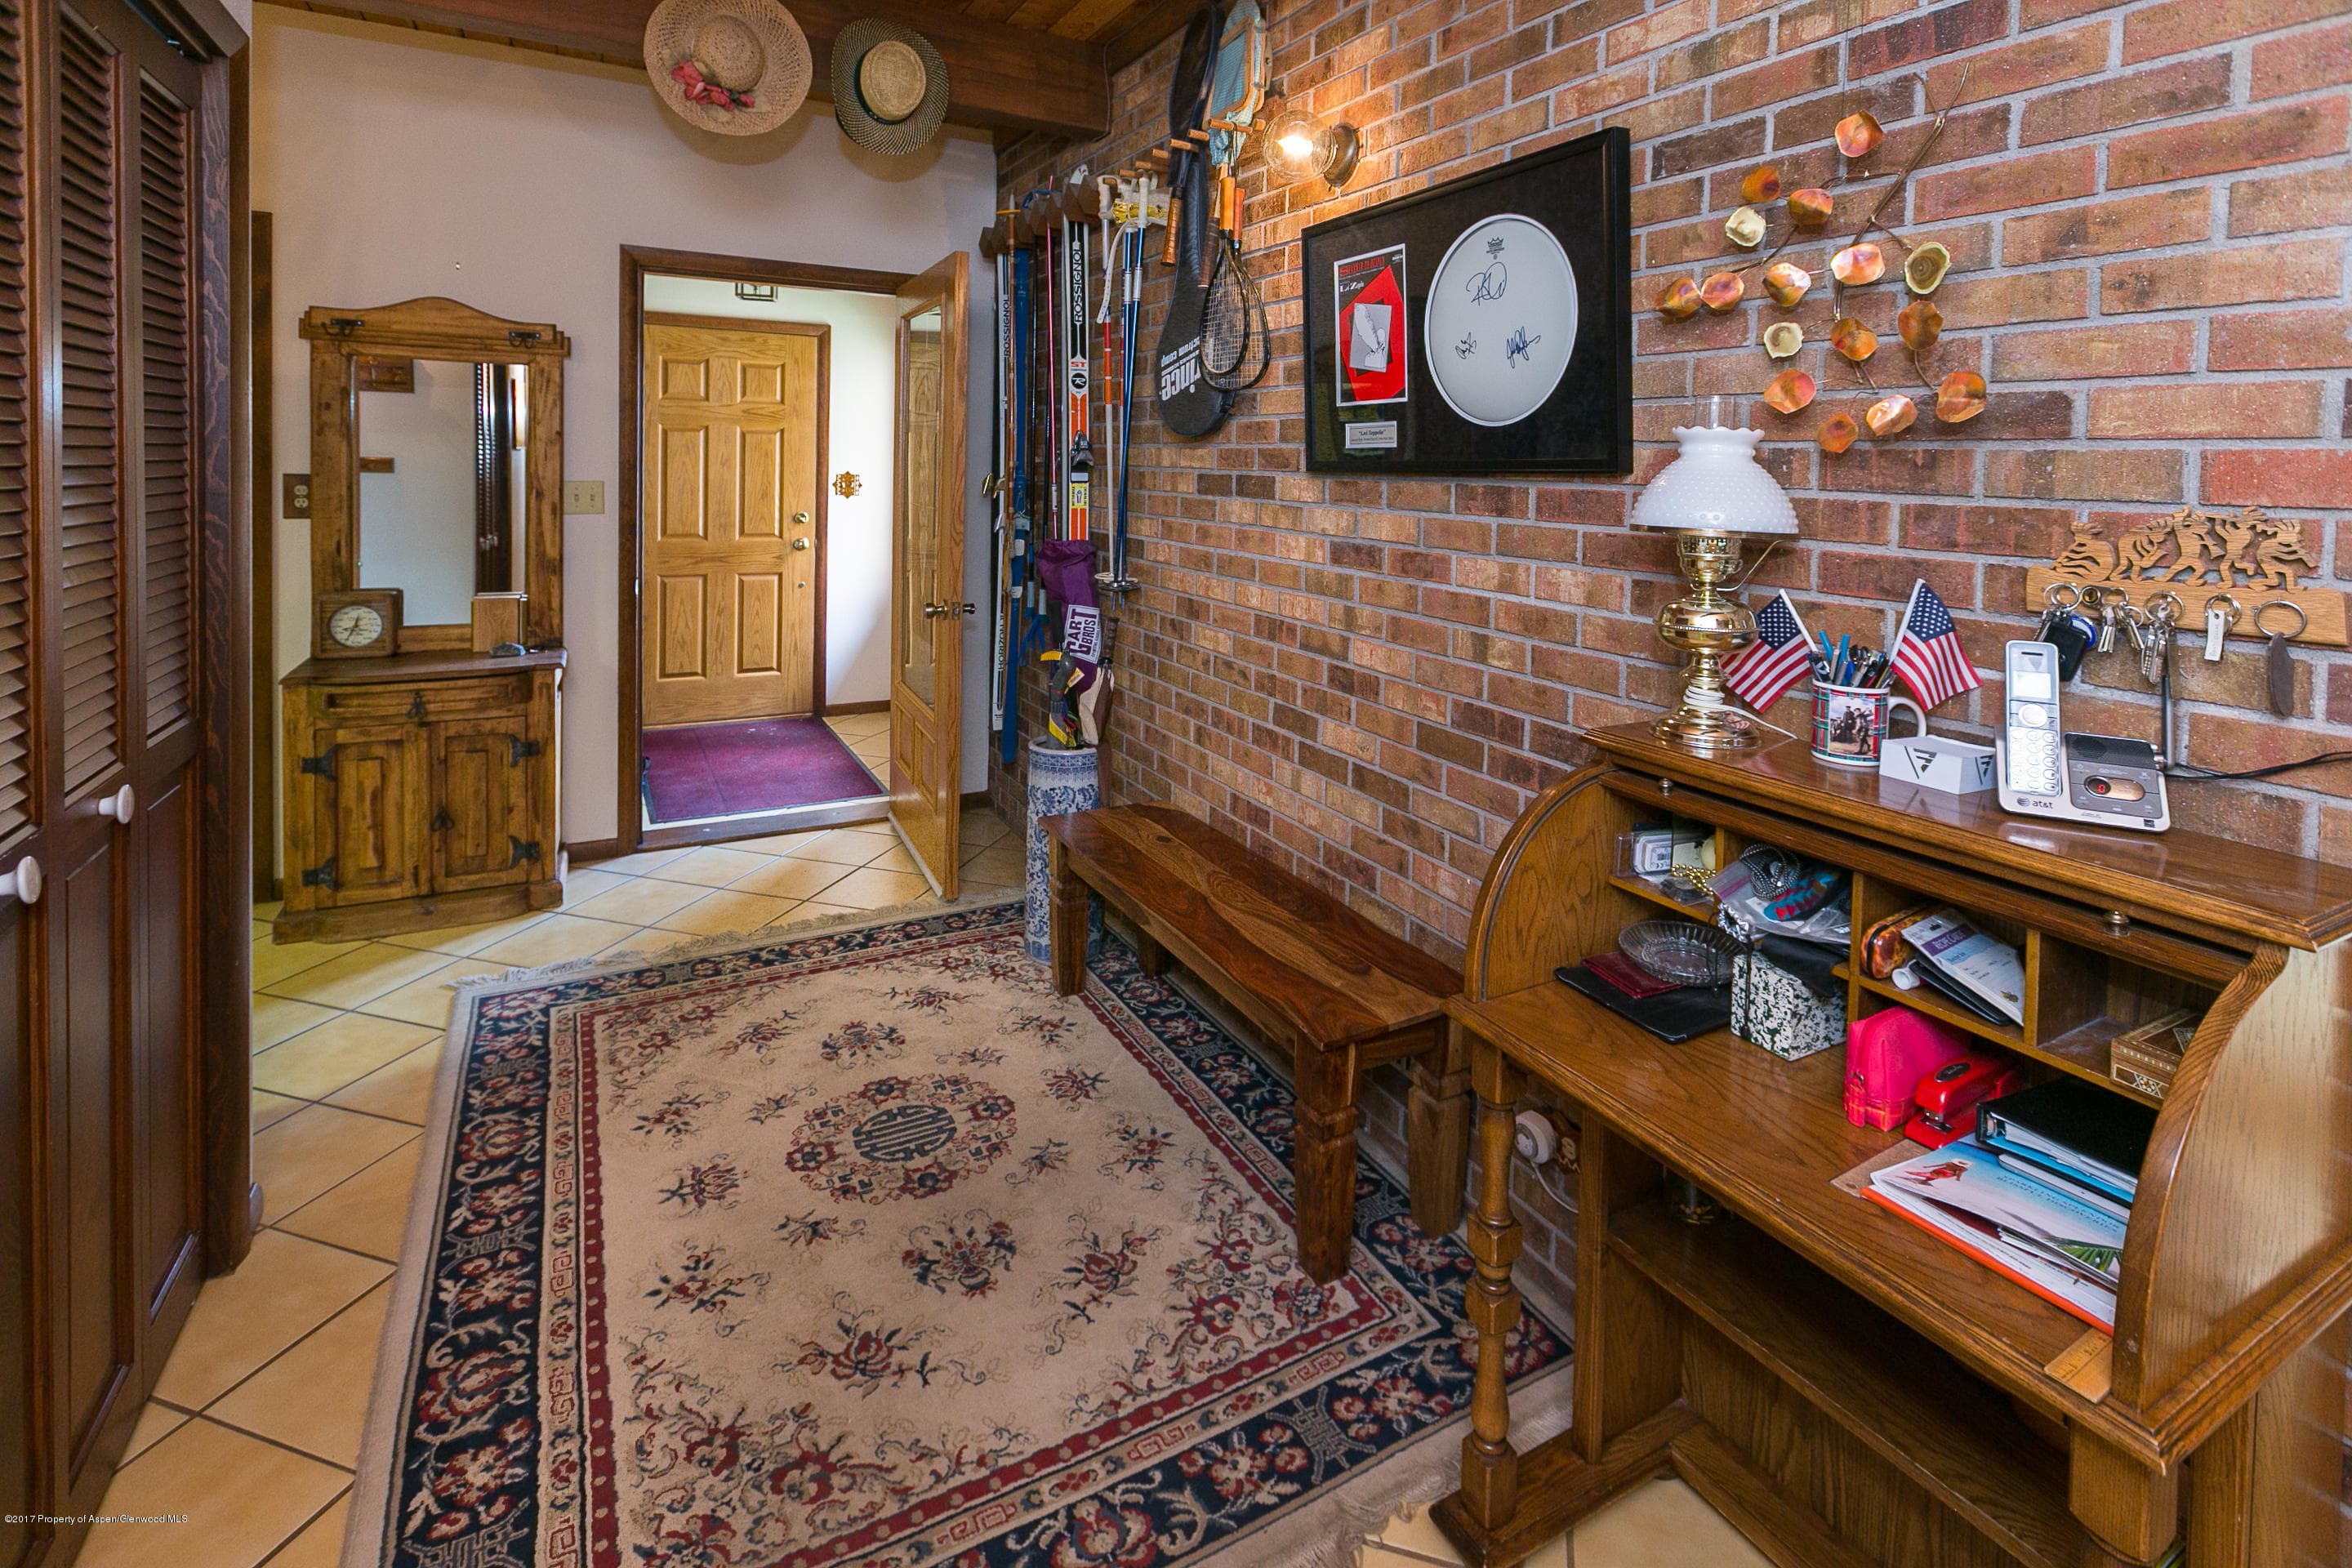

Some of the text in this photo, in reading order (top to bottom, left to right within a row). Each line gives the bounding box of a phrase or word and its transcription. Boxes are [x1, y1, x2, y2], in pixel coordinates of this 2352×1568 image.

[1073, 243, 1083, 323] ROSSIGNOL
[1160, 350, 1178, 368] comp
[1178, 336, 1200, 357] ectrum
[1161, 358, 1201, 401] rince
[1067, 608, 1098, 656] GART
[1081, 619, 1096, 645] BROS
[2032, 800, 2054, 809] at&t
